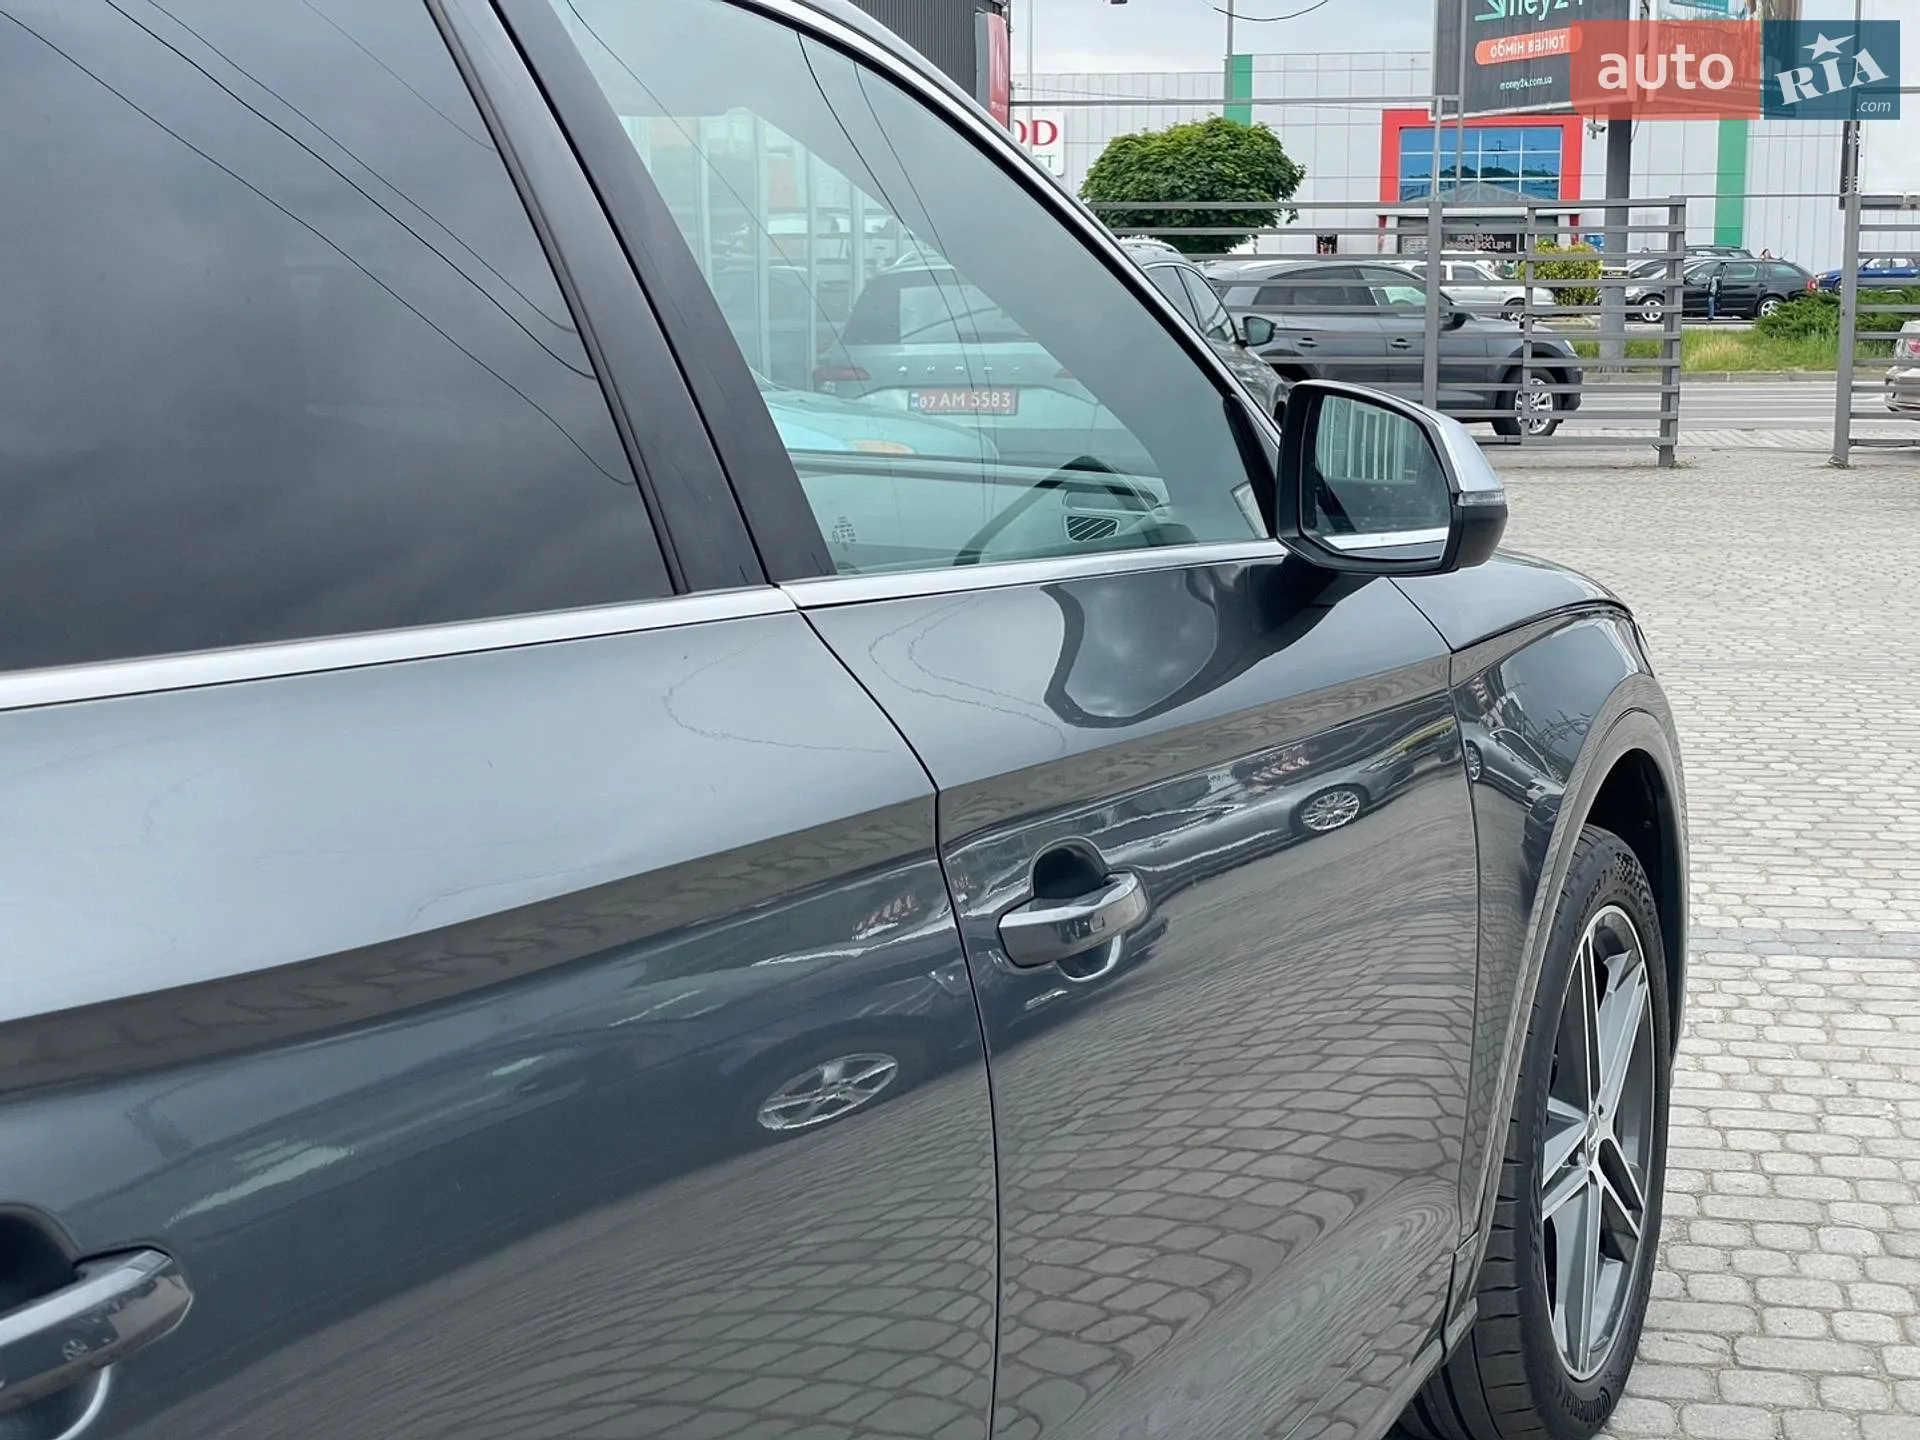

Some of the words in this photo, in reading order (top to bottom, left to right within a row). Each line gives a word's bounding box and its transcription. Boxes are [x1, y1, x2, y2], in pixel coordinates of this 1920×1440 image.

[1489, 38, 1525, 59] обмін
[1527, 34, 1567, 54] валют
[919, 396, 936, 409] 07
[939, 391, 965, 408] AM
